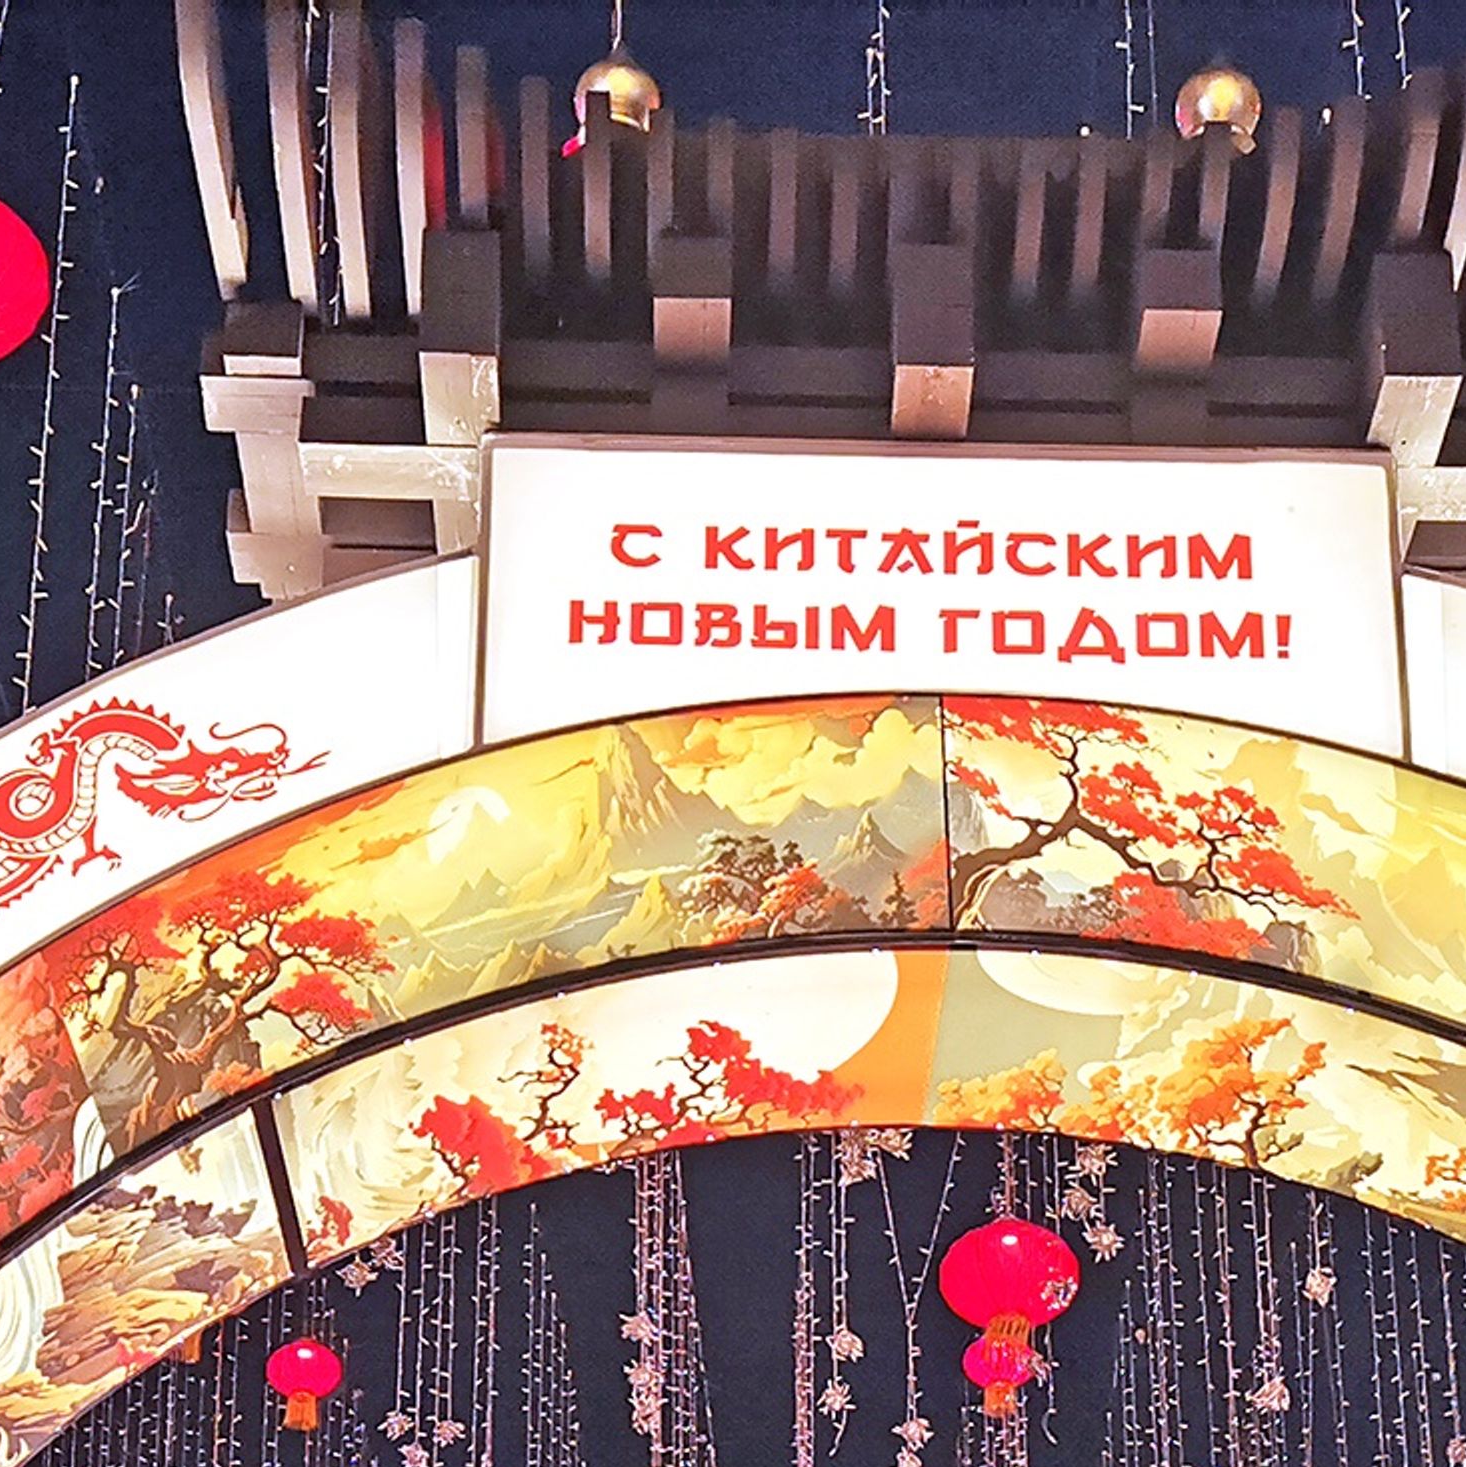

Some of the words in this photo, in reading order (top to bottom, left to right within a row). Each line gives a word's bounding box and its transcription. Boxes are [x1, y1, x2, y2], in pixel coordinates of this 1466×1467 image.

[610, 524, 662, 567] С
[704, 520, 1255, 580] КИТАЙСКИМ
[568, 600, 896, 652] НОВЫМ
[939, 607, 1291, 663] ГОДОМ!
